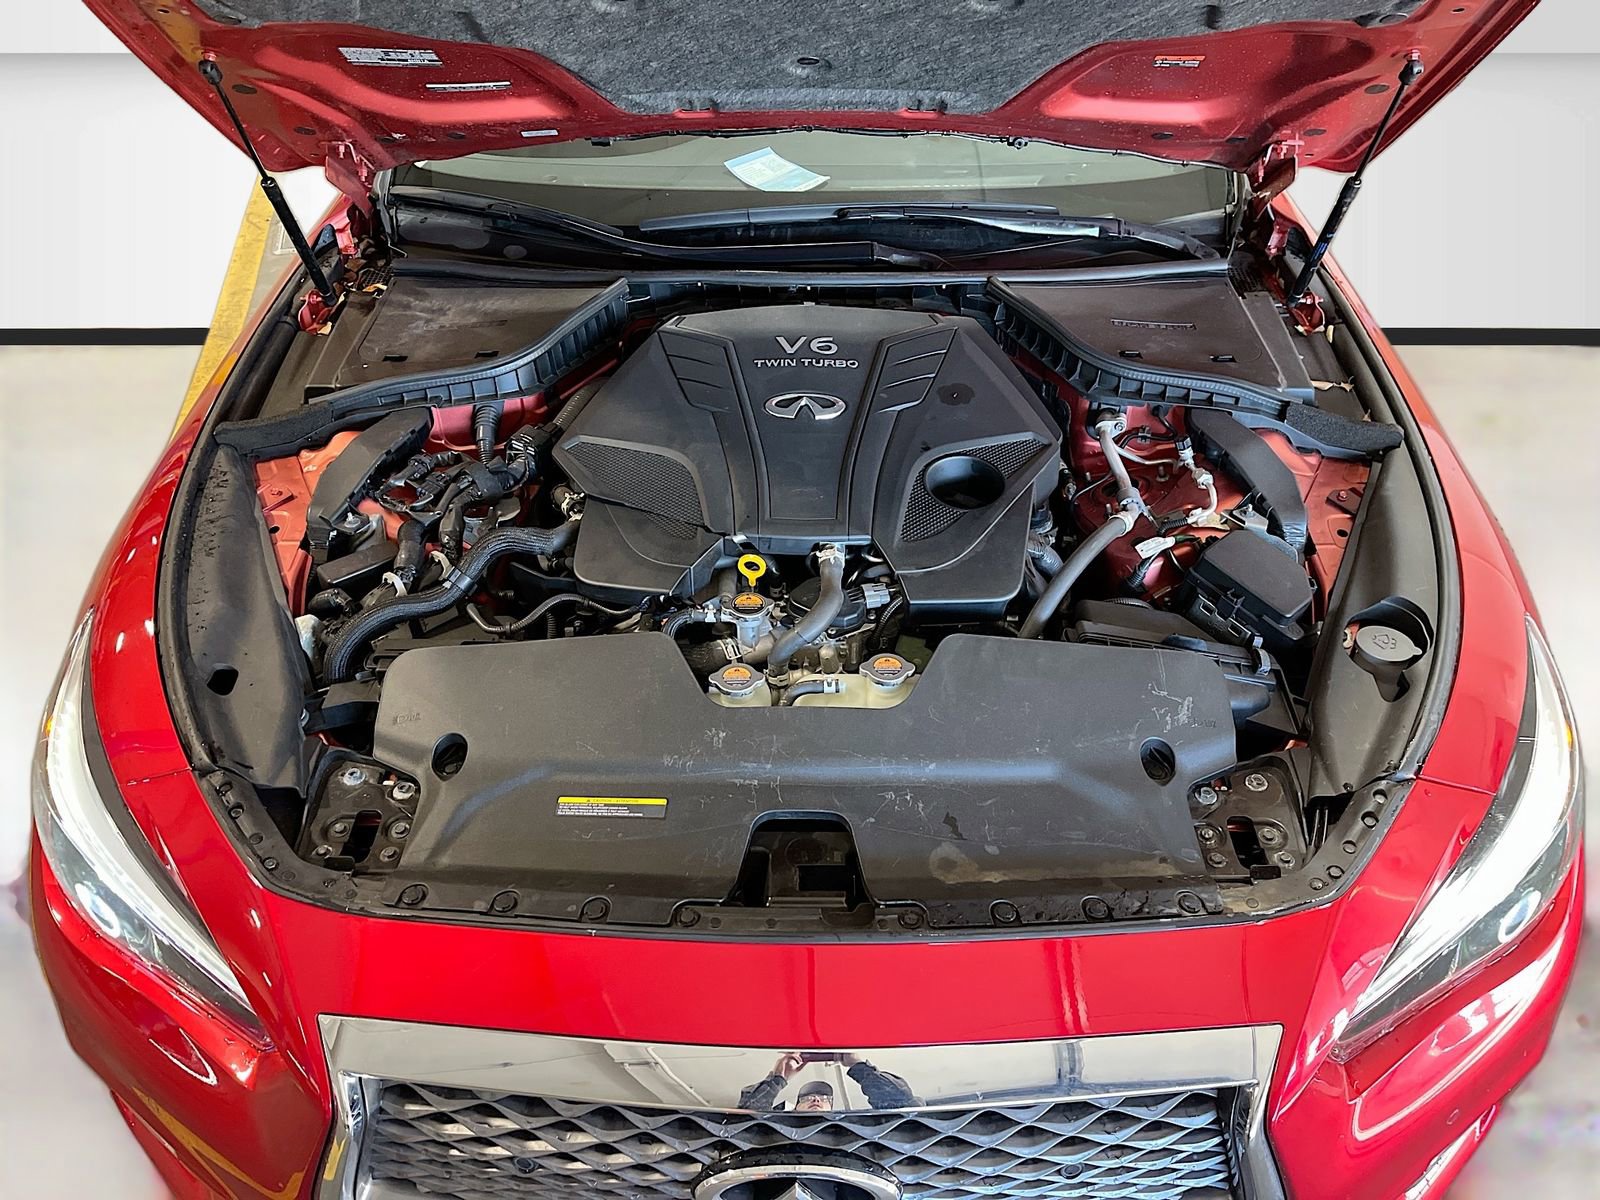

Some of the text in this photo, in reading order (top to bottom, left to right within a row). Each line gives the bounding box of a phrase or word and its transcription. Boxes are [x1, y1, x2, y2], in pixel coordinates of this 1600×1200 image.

[775, 336, 838, 355] V6
[754, 358, 859, 369] TWIN TURBO
